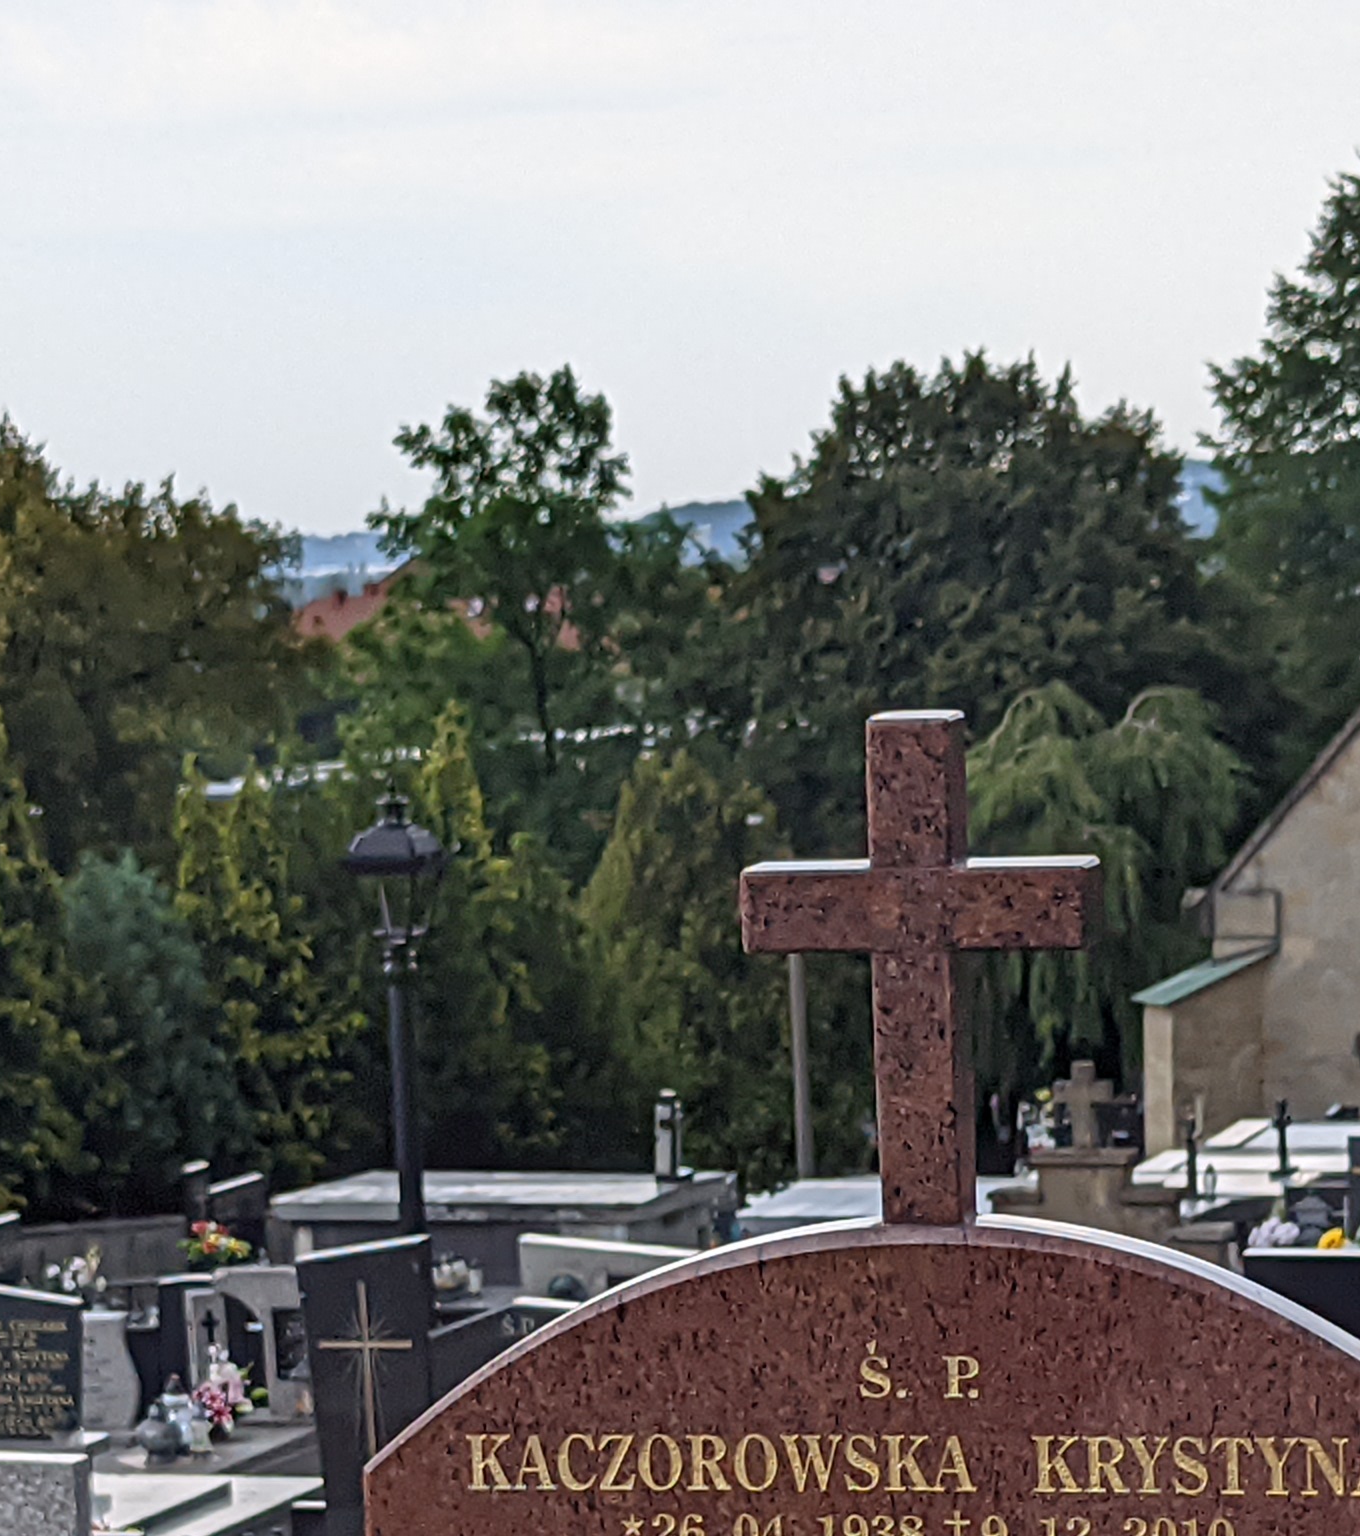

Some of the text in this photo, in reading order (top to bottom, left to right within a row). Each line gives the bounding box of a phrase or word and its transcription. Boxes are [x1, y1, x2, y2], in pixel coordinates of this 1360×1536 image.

[857, 1339, 981, 1400] Ś. P.
[466, 1432, 978, 1494] KACZOROWSKA
